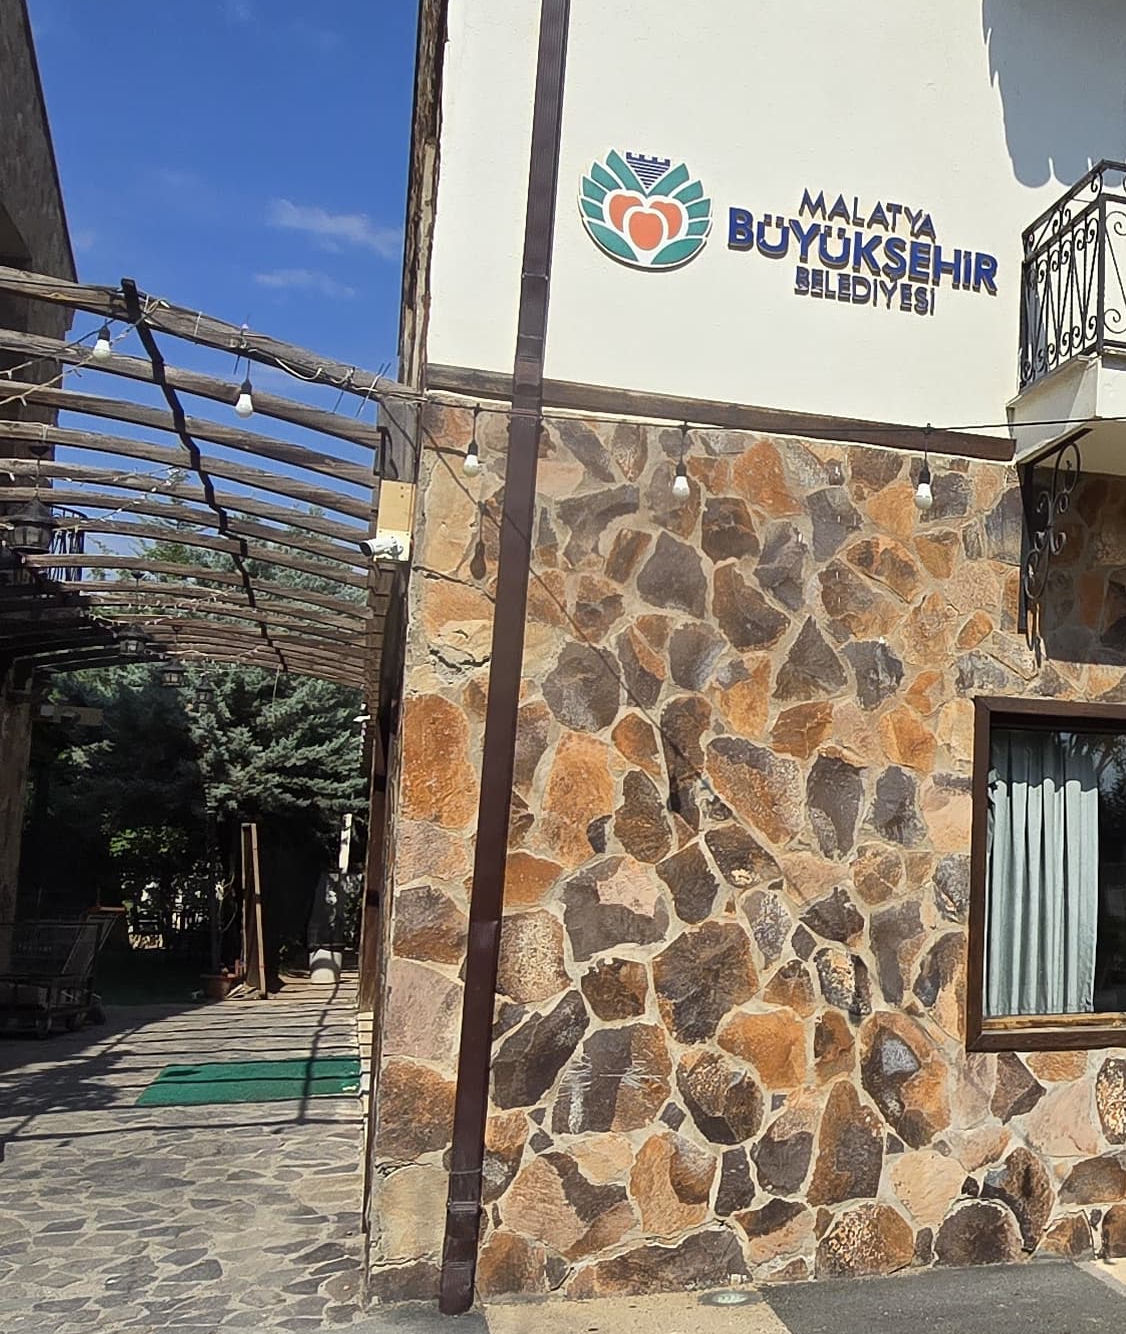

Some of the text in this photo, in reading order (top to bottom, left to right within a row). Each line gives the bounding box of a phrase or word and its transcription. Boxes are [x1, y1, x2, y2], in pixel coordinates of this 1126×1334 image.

[799, 188, 937, 243] MALATYA
[728, 207, 998, 295] BÜYÜKŞEHİR
[794, 266, 936, 316] BELEDİYESİ
